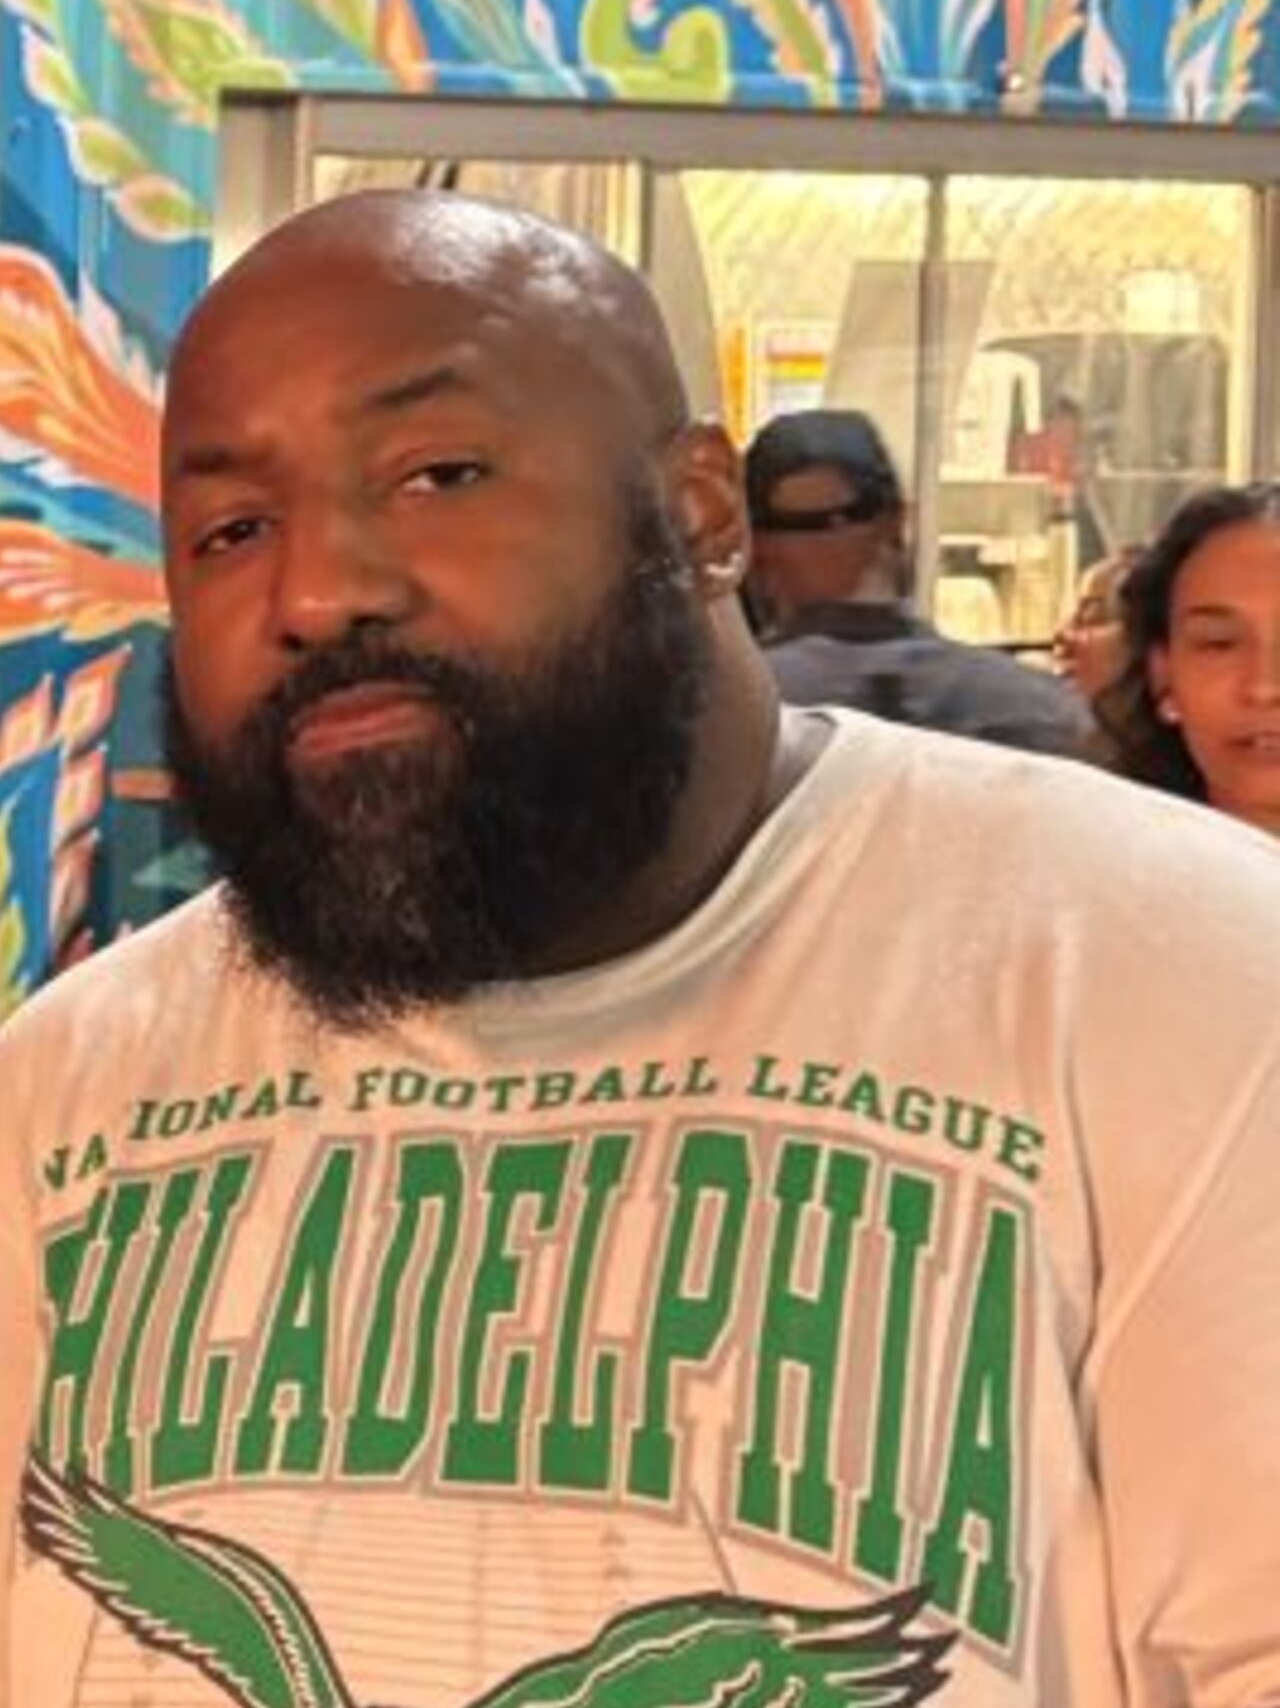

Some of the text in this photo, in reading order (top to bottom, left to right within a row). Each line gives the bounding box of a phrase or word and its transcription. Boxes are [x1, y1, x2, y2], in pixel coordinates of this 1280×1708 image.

[348, 1056, 719, 1115] FOOTBALL
[748, 1054, 1046, 1181] LEAGUE
[38, 1121, 1032, 1671] HILADELPHIA
